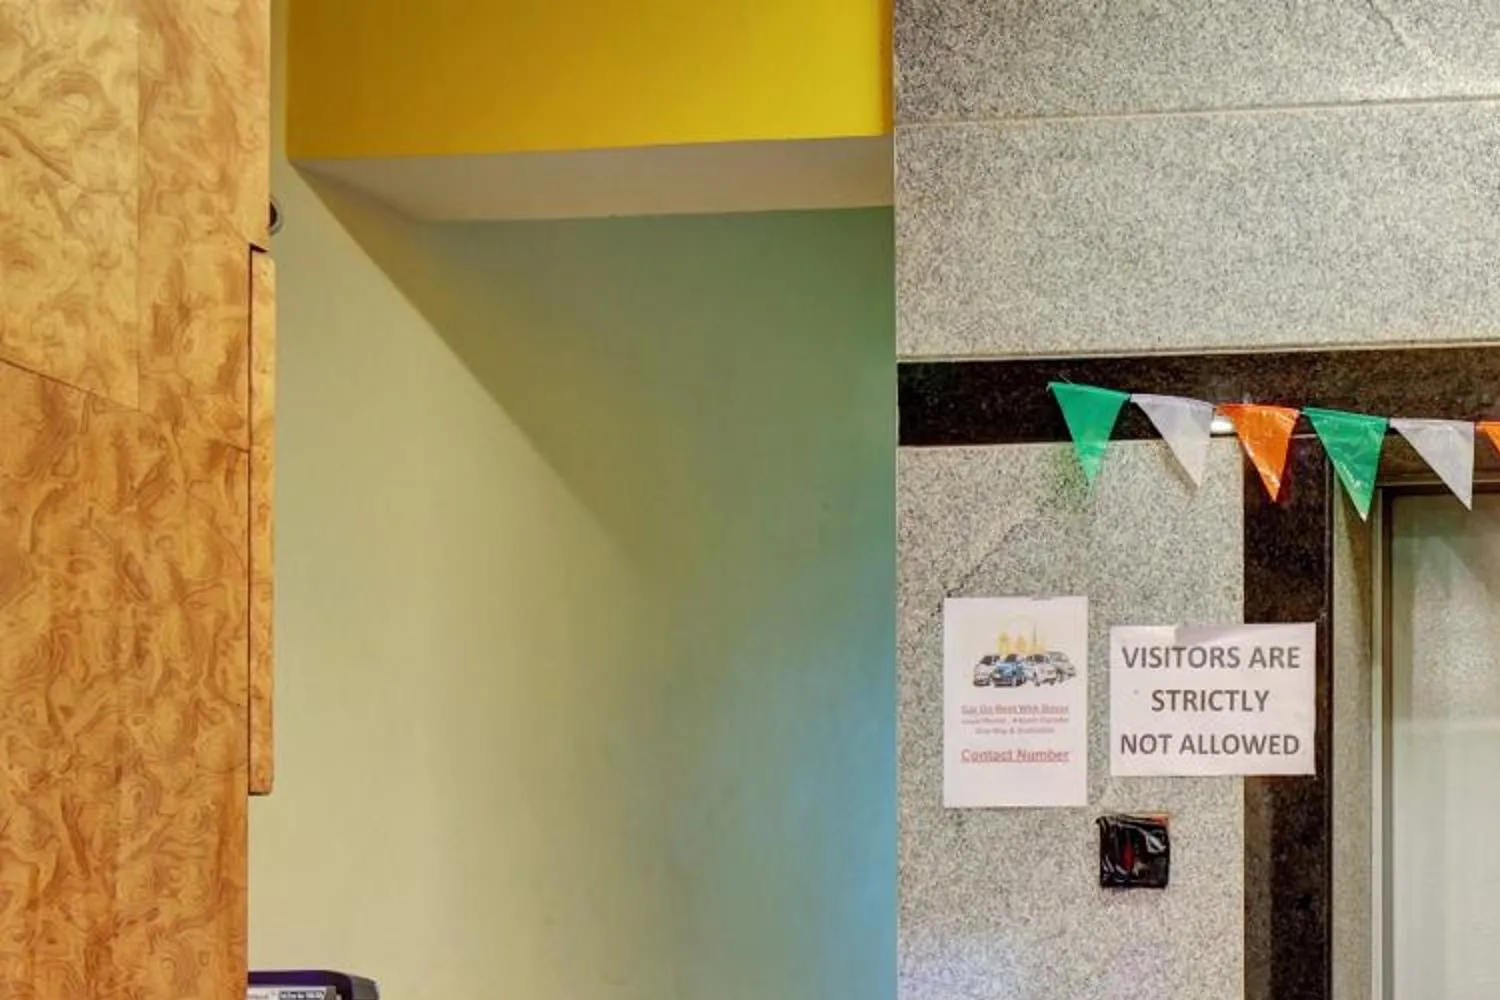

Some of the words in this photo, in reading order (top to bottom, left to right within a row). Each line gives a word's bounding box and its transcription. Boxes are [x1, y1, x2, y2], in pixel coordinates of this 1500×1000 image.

[1121, 646, 1241, 669] VISITORS
[1248, 646, 1301, 669] ARE
[1151, 689, 1270, 712] STRICTLY
[1120, 733, 1172, 755] NOT
[1179, 733, 1300, 755] ALLOWED
[961, 748, 1013, 763] Contact
[1017, 748, 1069, 763] Number
